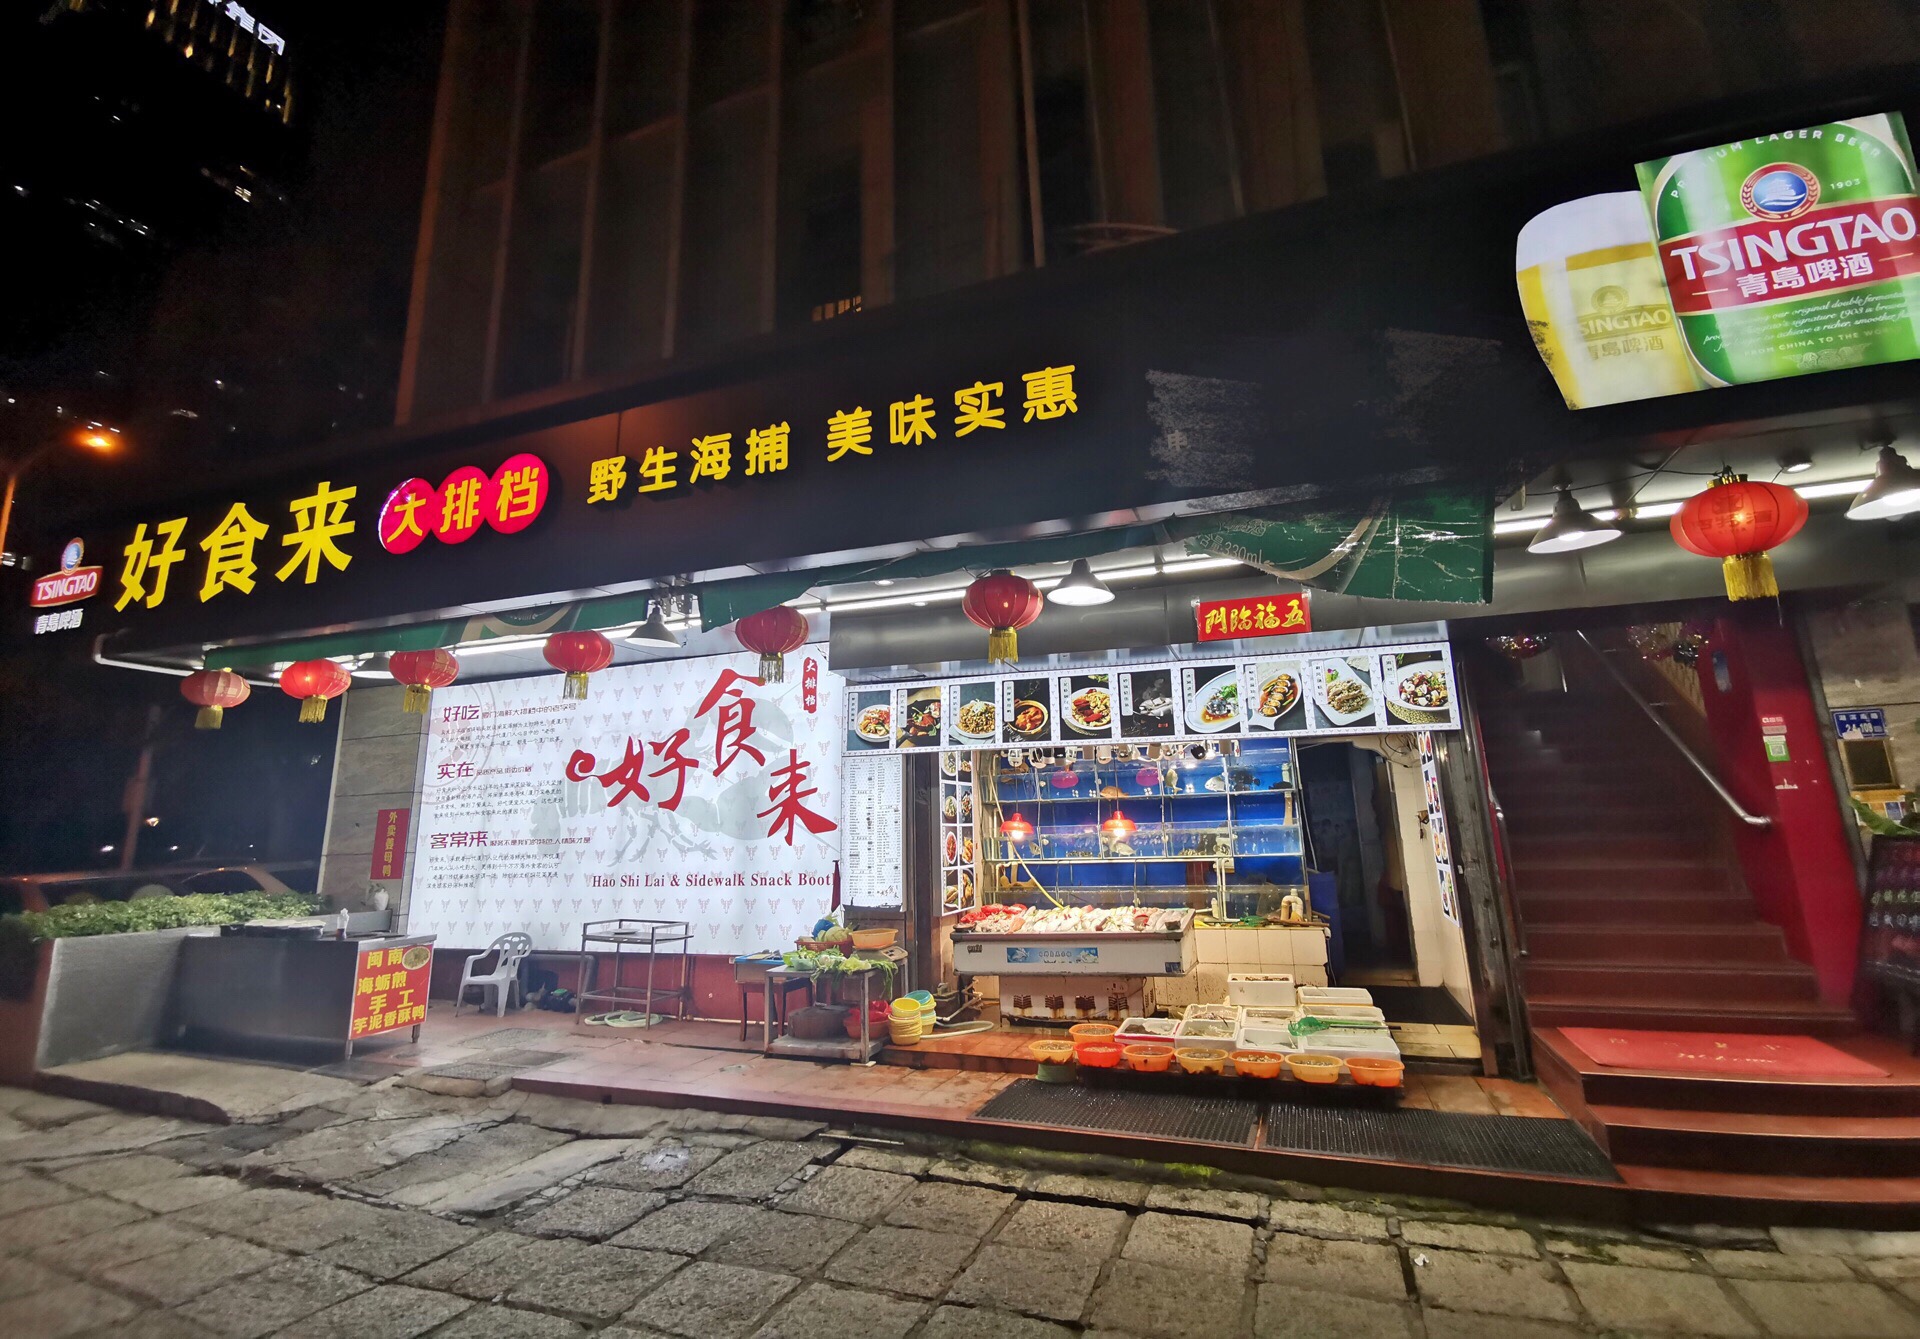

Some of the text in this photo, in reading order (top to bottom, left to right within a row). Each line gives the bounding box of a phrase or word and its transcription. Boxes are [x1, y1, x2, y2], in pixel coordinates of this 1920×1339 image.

[1671, 129, 1881, 198] PRIUM LAGER BEER
[1829, 178, 1862, 191] 1903
[1669, 207, 1916, 281] TSINGTAO
[1791, 300, 1831, 317] original
[1831, 295, 1862, 308] double
[1792, 312, 1838, 328] signature
[1840, 306, 1864, 319] 1903
[1779, 339, 1815, 351] CHINA
[1819, 335, 1834, 345] TO
[1838, 331, 1859, 341] THE
[586, 365, 1079, 504] 野生海捕 美味实惠
[387, 466, 540, 543] 大排档
[114, 481, 358, 612] 好食来
[37, 571, 98, 601] TSINGTAO
[804, 659, 817, 707] 大排档
[443, 704, 481, 723] 好吃
[437, 761, 475, 780] 实在
[566, 669, 838, 847] 好食来
[430, 830, 489, 850] 客常来
[592, 875, 616, 887] Hao
[620, 874, 639, 887] Shi
[644, 874, 665, 887] Lai
[670, 875, 680, 887] &
[685, 873, 745, 887] Sidewalk
[750, 873, 792, 887] Snack
[367, 948, 404, 970] 闽南
[357, 970, 407, 996] 海蛎煎
[368, 989, 414, 1015] 手工
[353, 1004, 425, 1034] 芋泥香酥鸭
